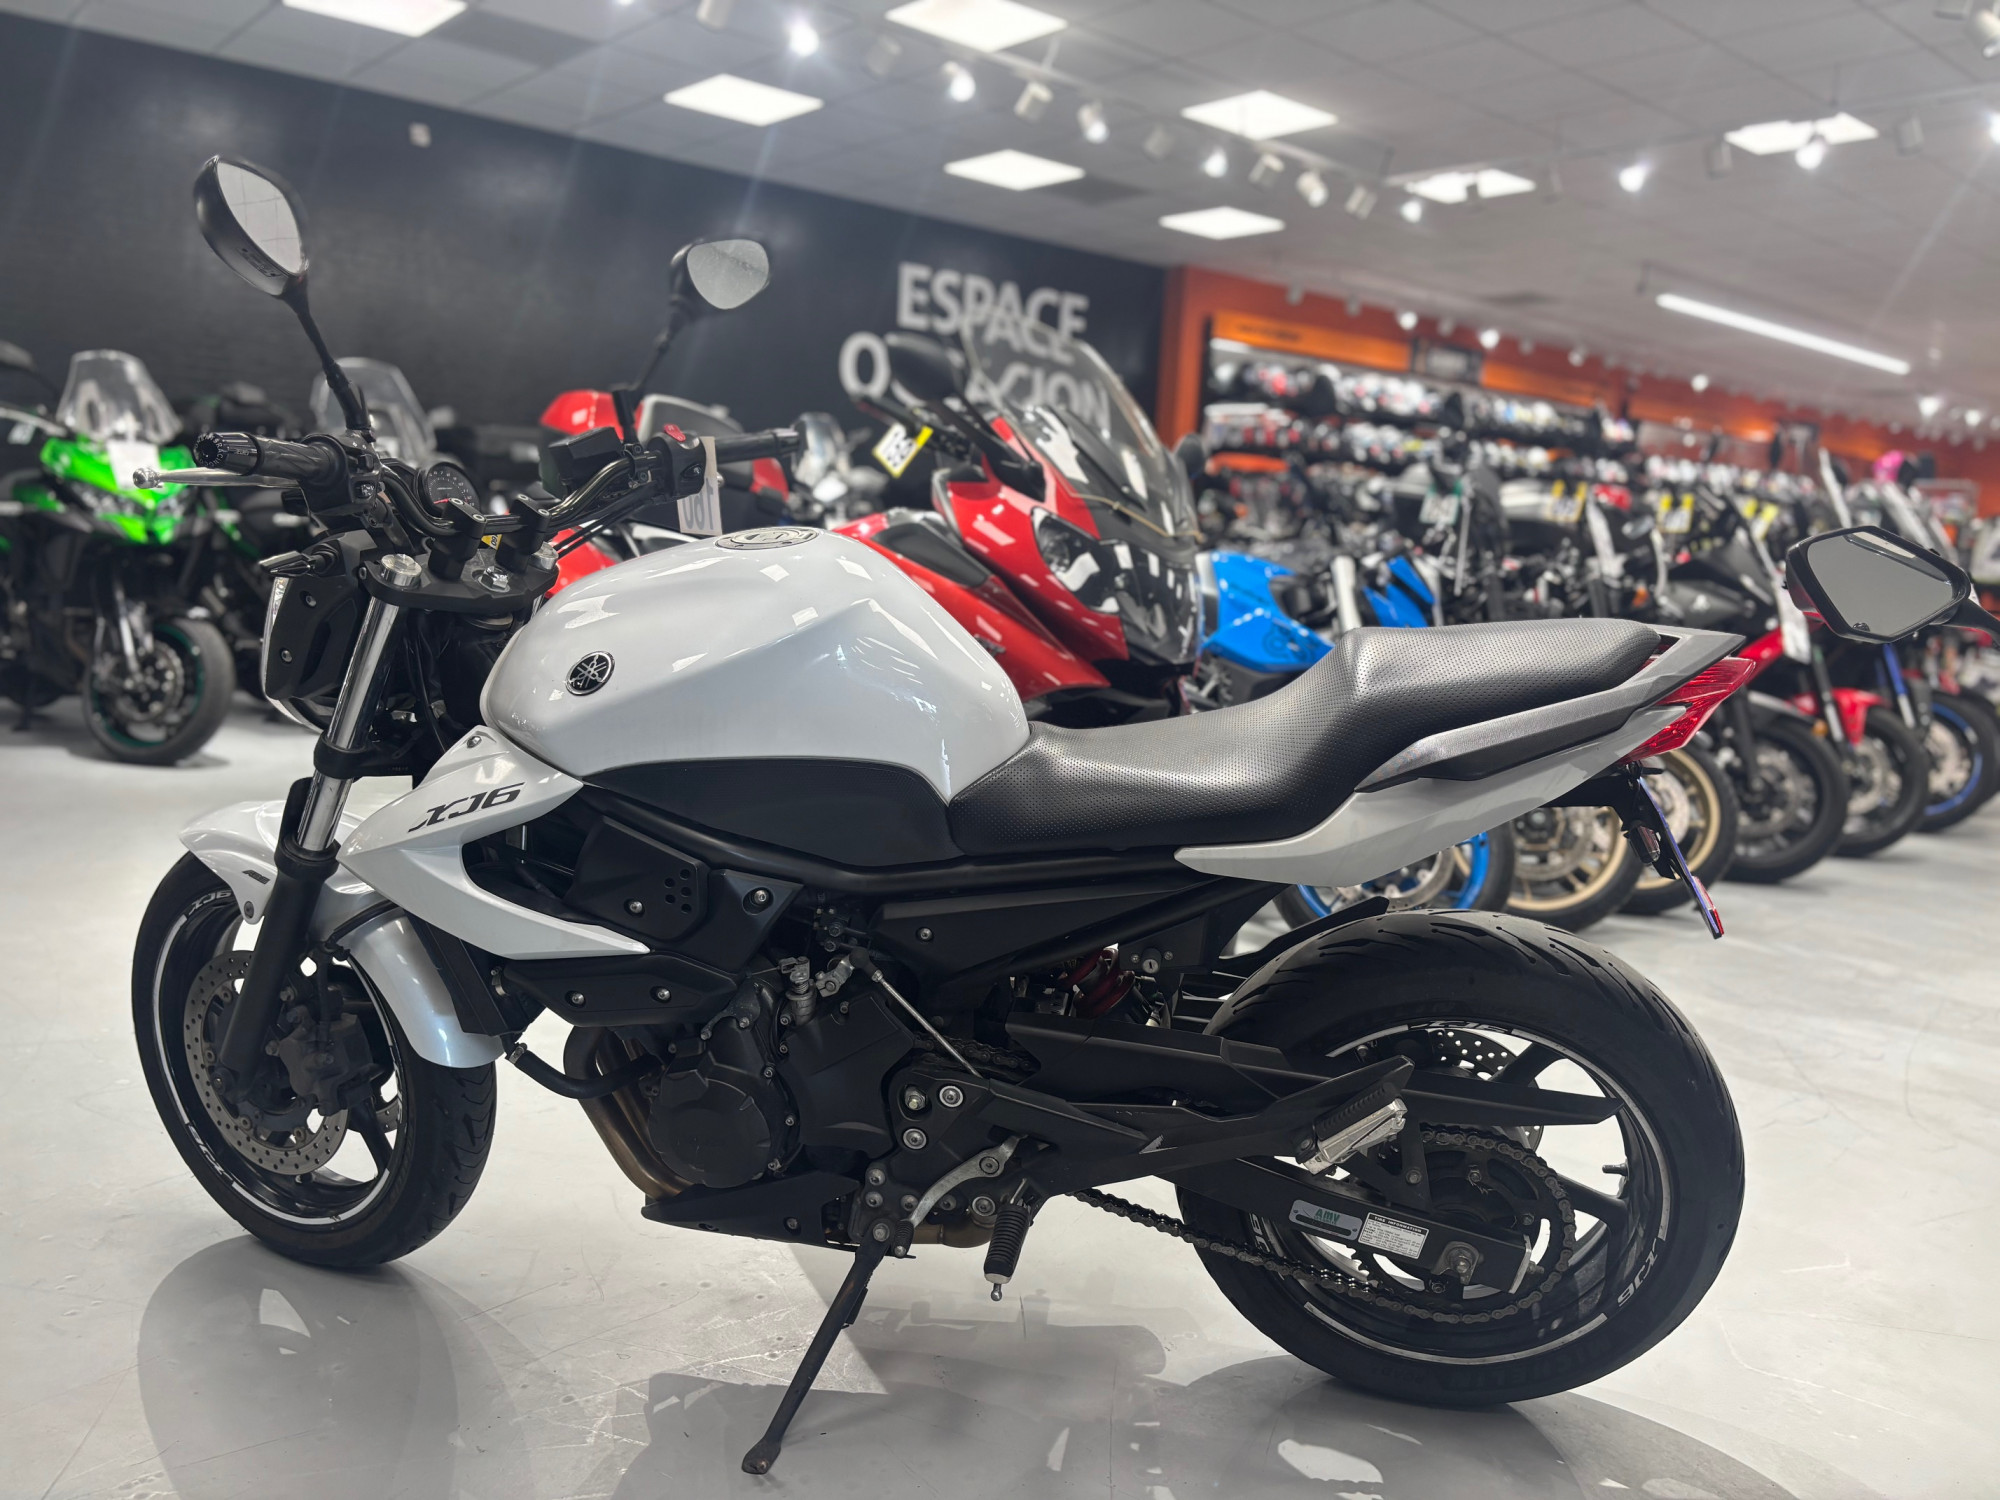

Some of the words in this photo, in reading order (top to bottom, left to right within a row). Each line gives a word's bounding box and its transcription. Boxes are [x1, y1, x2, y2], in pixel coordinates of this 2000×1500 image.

[897, 261, 1089, 362] ESPACE
[407, 782, 525, 833] XJ6
[188, 889, 232, 916] XJ6
[1617, 1237, 1658, 1307] XJ6
